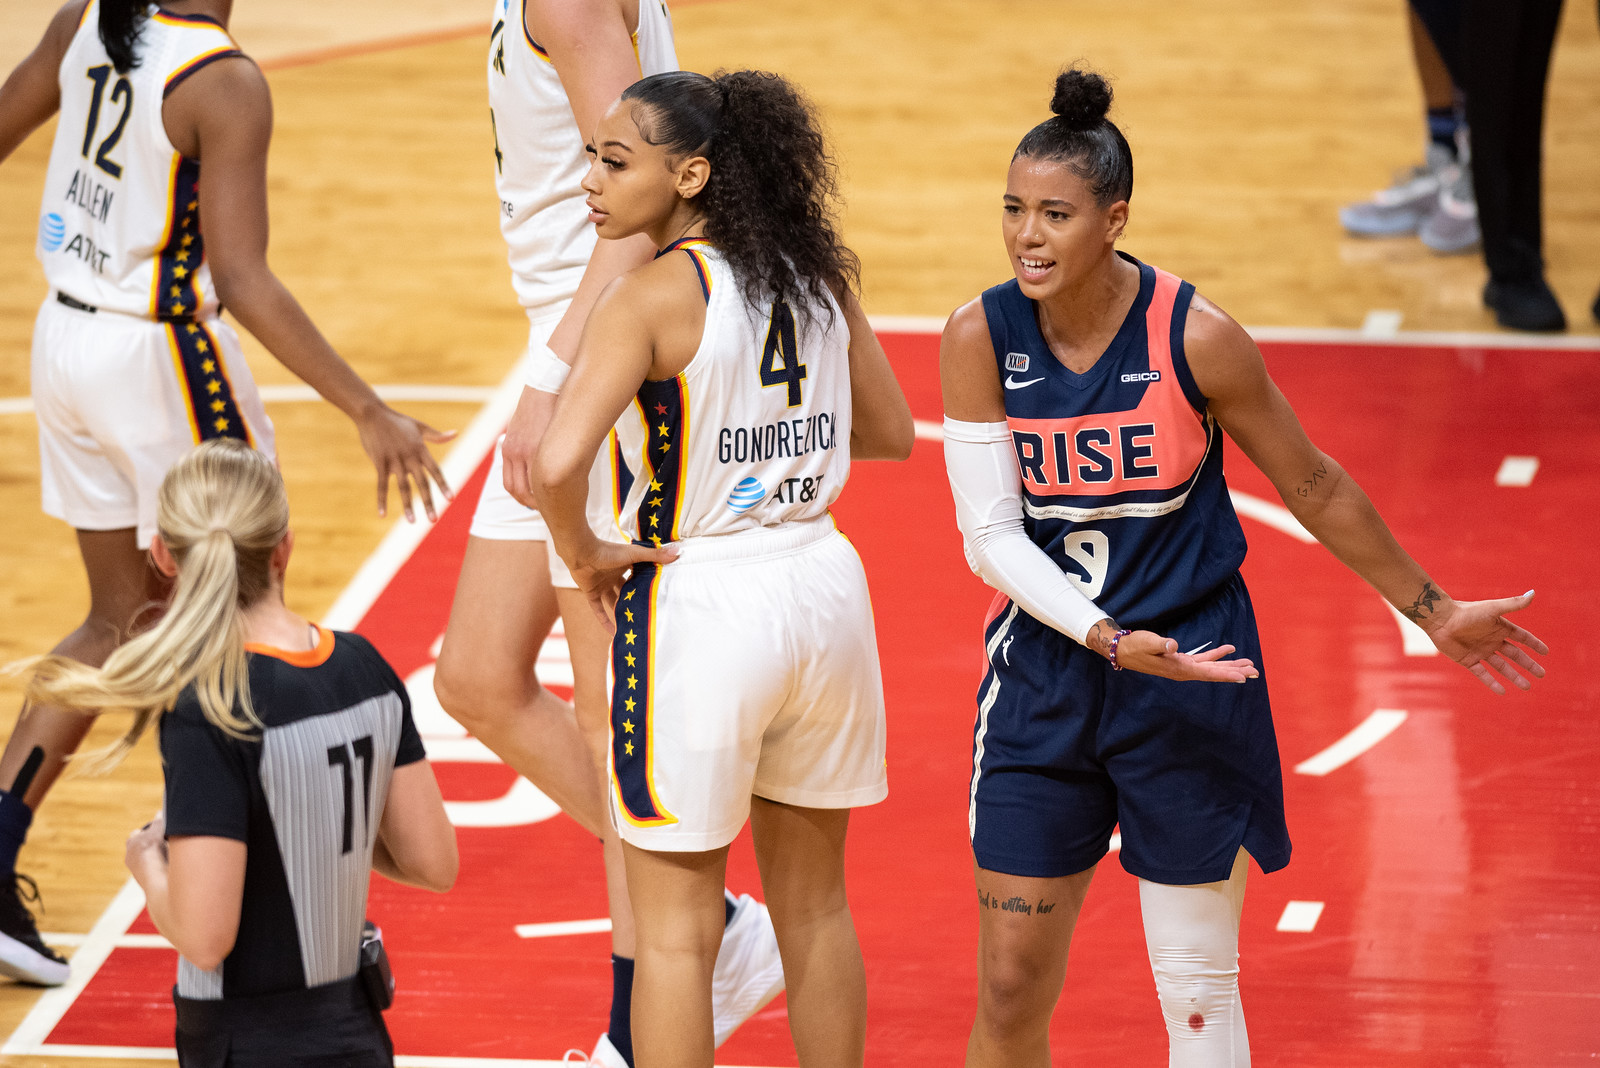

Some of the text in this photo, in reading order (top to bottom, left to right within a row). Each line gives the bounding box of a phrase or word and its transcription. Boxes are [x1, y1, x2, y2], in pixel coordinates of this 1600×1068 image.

[82, 64, 134, 180] 12
[65, 169, 114, 224] ALLEN
[65, 234, 110, 275] AT&T
[760, 302, 807, 409] 4
[1121, 372, 1160, 382] GEICO
[719, 411, 837, 464] GONDREZICK
[1011, 423, 1159, 486] RISE
[767, 474, 825, 506] AT&T
[1064, 530, 1109, 600] 9
[327, 735, 374, 856] 11
[992, 897, 998, 909] is
[1002, 897, 1032, 916] within
[1036, 899, 1056, 914] her
